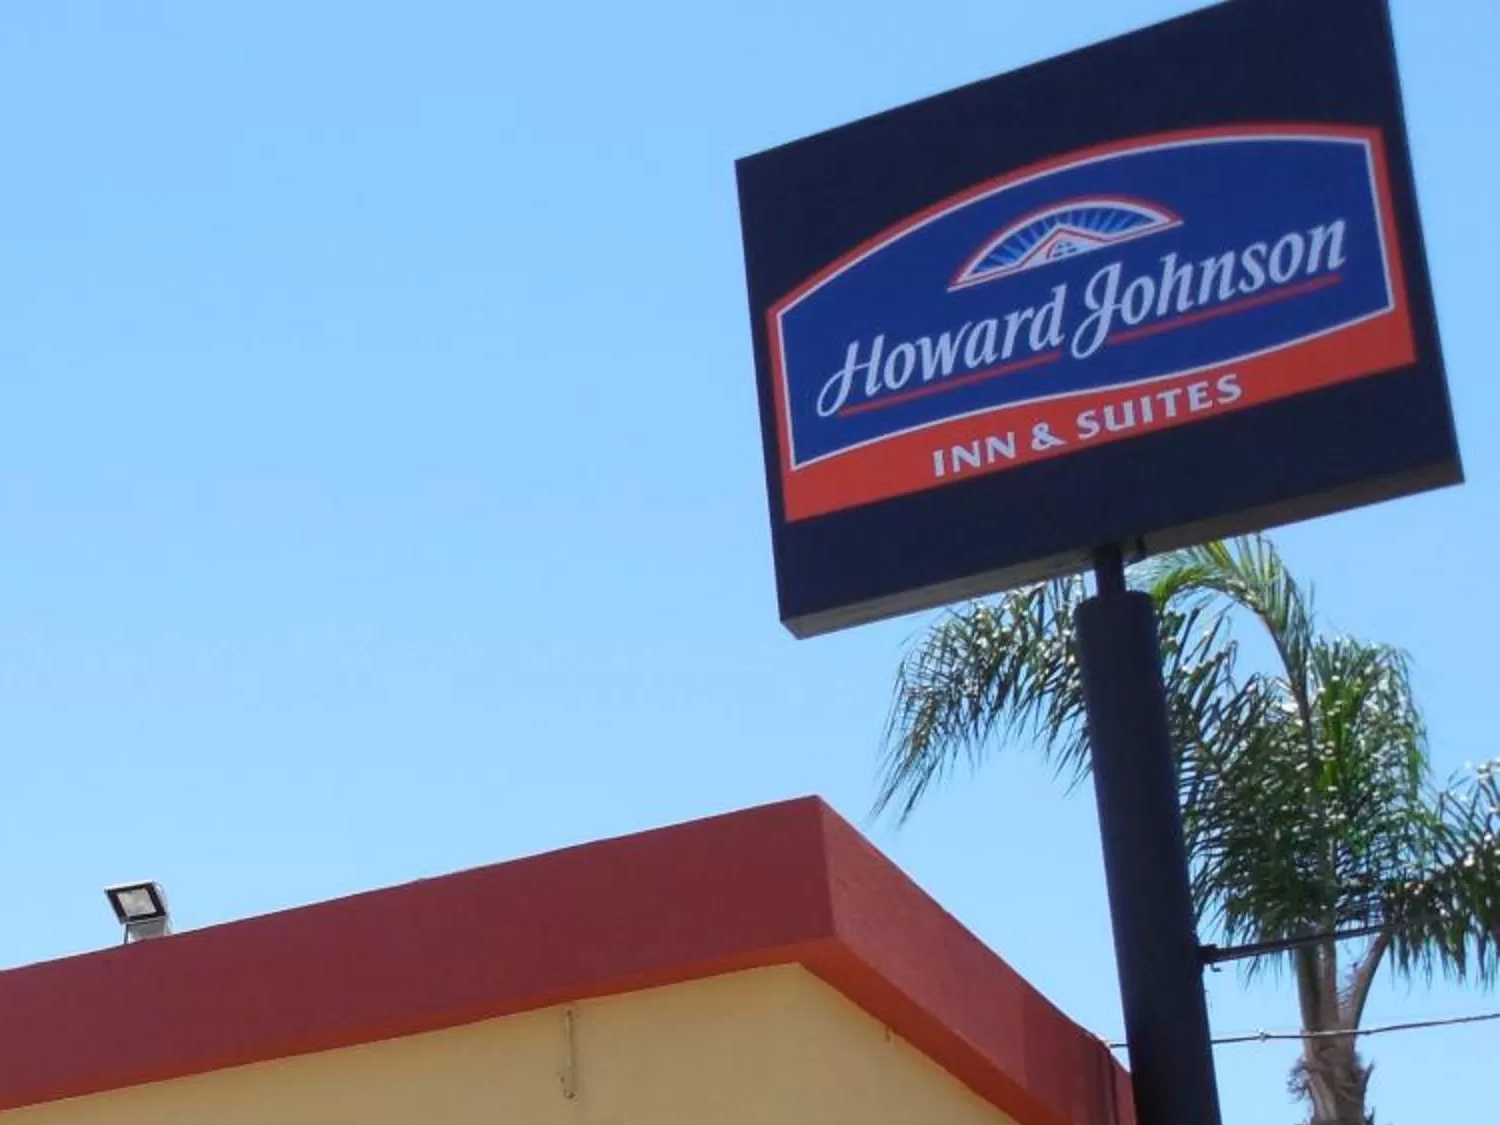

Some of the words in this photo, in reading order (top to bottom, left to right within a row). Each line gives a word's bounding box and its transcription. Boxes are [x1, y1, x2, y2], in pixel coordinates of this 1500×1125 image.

[815, 282, 1068, 418] Howard
[1070, 216, 1347, 360] Johnson
[932, 430, 1016, 478] INN
[1030, 422, 1068, 451] &
[1075, 372, 1243, 441] SUITES
